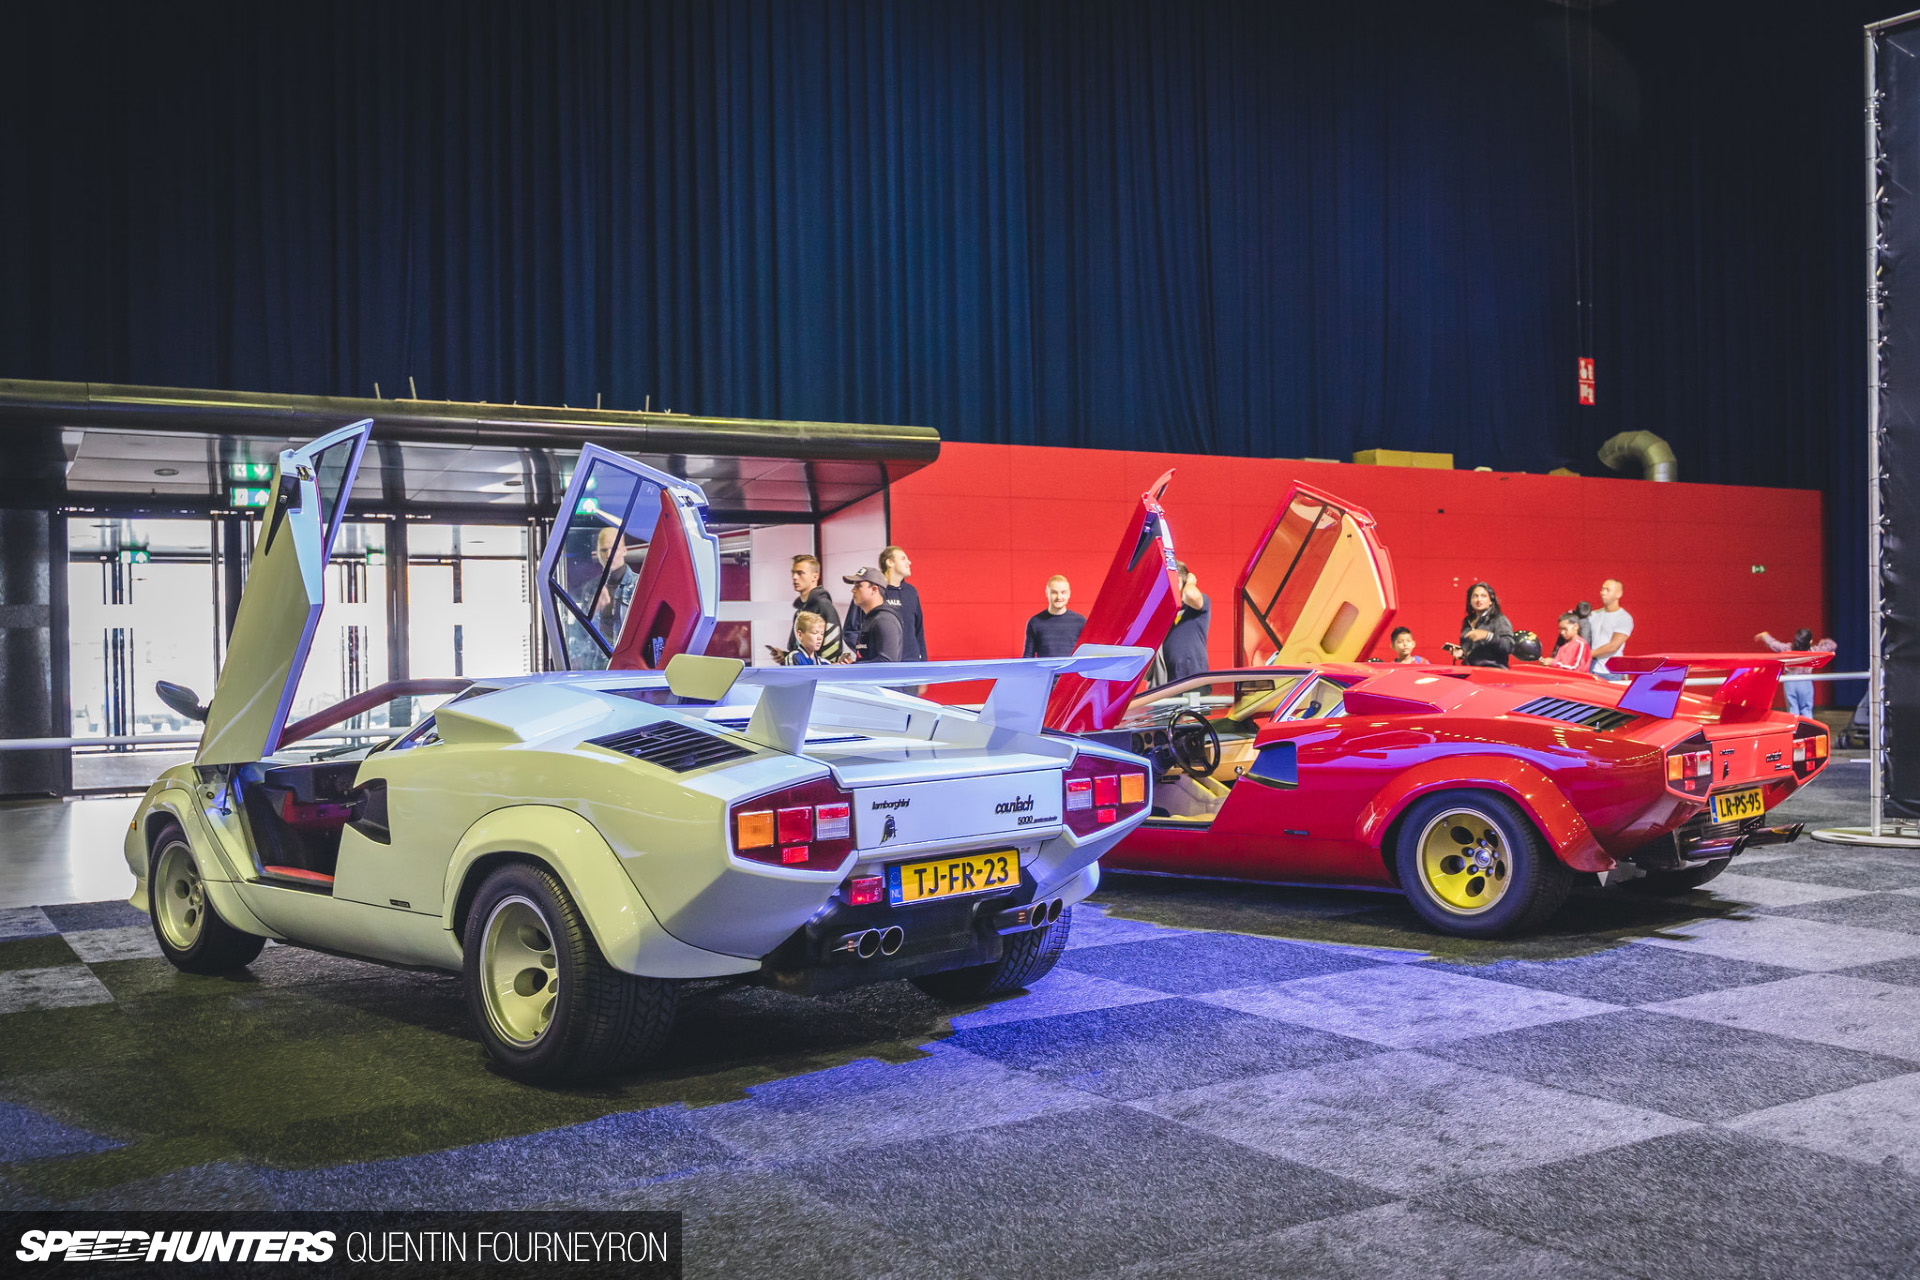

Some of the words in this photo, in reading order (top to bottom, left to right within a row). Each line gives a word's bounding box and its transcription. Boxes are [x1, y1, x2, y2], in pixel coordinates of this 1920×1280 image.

[1719, 792, 1761, 817] LR-PS-95
[1018, 815, 1034, 826] 5000
[914, 856, 1009, 897] TJ-FR-23
[891, 889, 901, 899] NL
